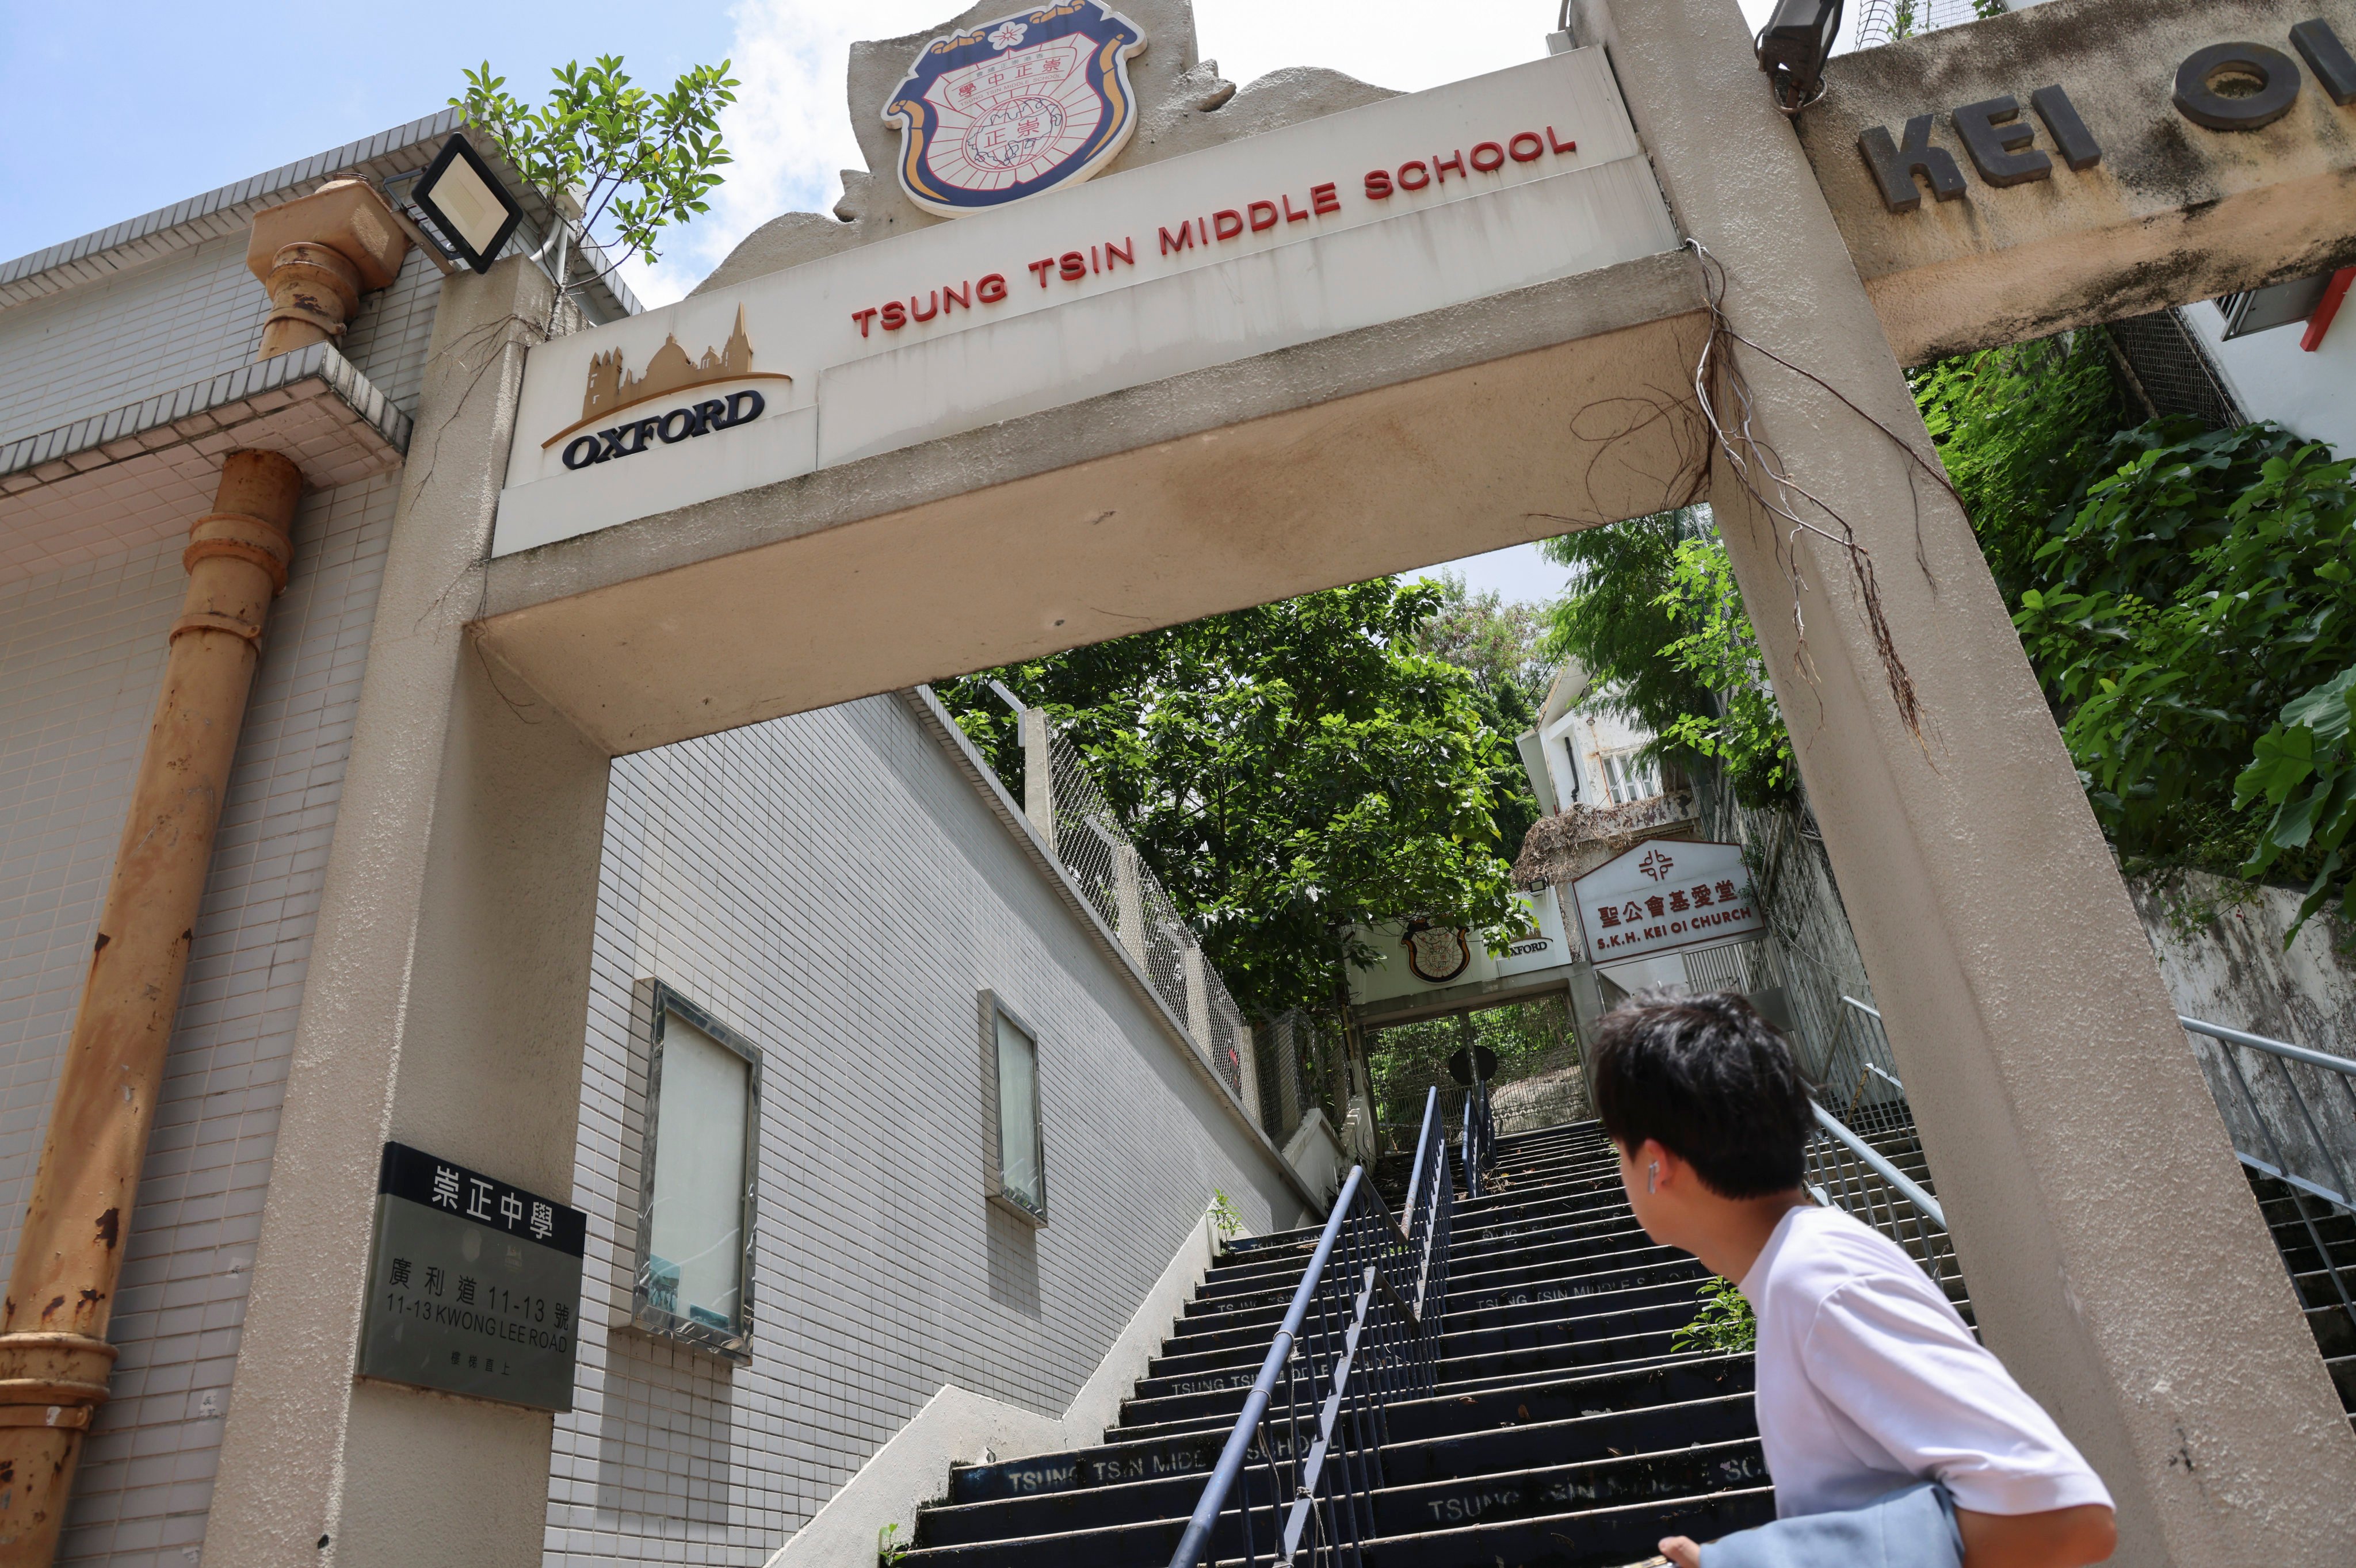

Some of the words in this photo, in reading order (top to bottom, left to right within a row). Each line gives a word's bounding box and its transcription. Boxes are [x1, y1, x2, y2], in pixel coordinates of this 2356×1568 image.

[961, 94, 984, 106] TSUNG
[1004, 79, 1029, 90] MIDDLE
[1033, 74, 1061, 83] SCHOOL
[1858, 85, 2102, 212] KEI
[2172, 18, 2356, 131] OI
[852, 272, 1007, 337] TSUNG
[1029, 236, 1135, 289] TSIN
[1158, 181, 1341, 255] MIDDLE
[1364, 124, 1576, 200] SCHOOL
[562, 389, 765, 470] OXFORD
[1597, 931, 1640, 949] S.K.H.
[1644, 925, 1667, 939] KEI
[1671, 920, 1687, 934] OI
[1691, 907, 1751, 930] CHURCH
[1598, 879, 1738, 928] 聖公會基愛堂
[1502, 942, 1547, 957] XFORD
[432, 1165, 553, 1239] 崇正中學
[387, 1293, 432, 1321] 11-13
[436, 1305, 496, 1336] KWONG
[500, 1321, 525, 1344] LEE
[530, 1328, 567, 1353] ROAD
[1171, 1379, 1224, 1395] TSUNG
[1231, 1374, 1261, 1387] TSI
[1093, 1458, 1143, 1481] TSIN
